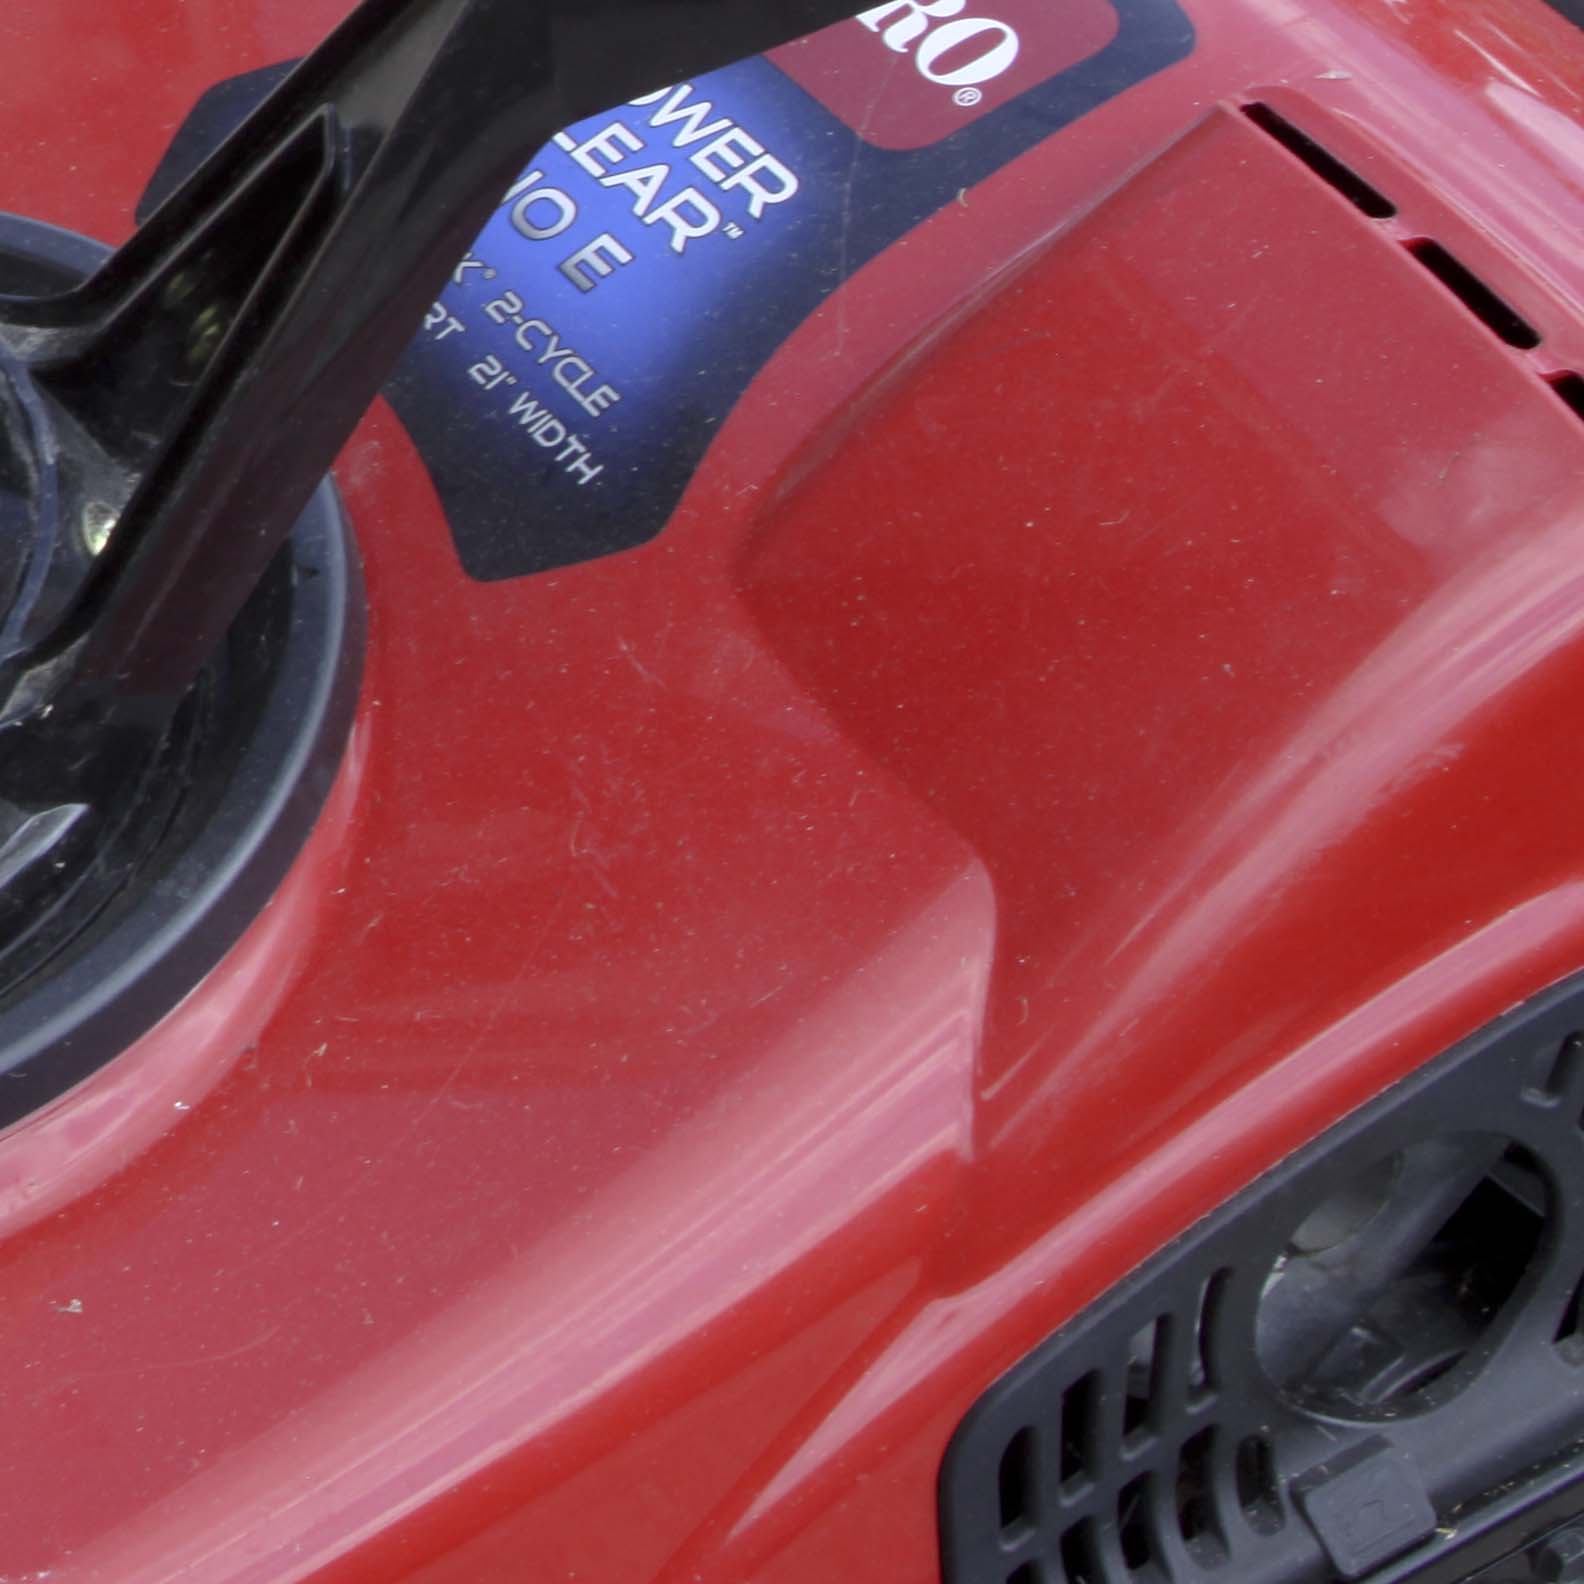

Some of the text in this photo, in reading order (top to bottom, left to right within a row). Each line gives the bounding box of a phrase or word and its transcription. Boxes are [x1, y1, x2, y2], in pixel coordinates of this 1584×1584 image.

[628, 84, 800, 218] WER
[556, 232, 635, 293] E
[485, 291, 621, 417] 2-CYCLE
[508, 391, 605, 486] WIDTH
